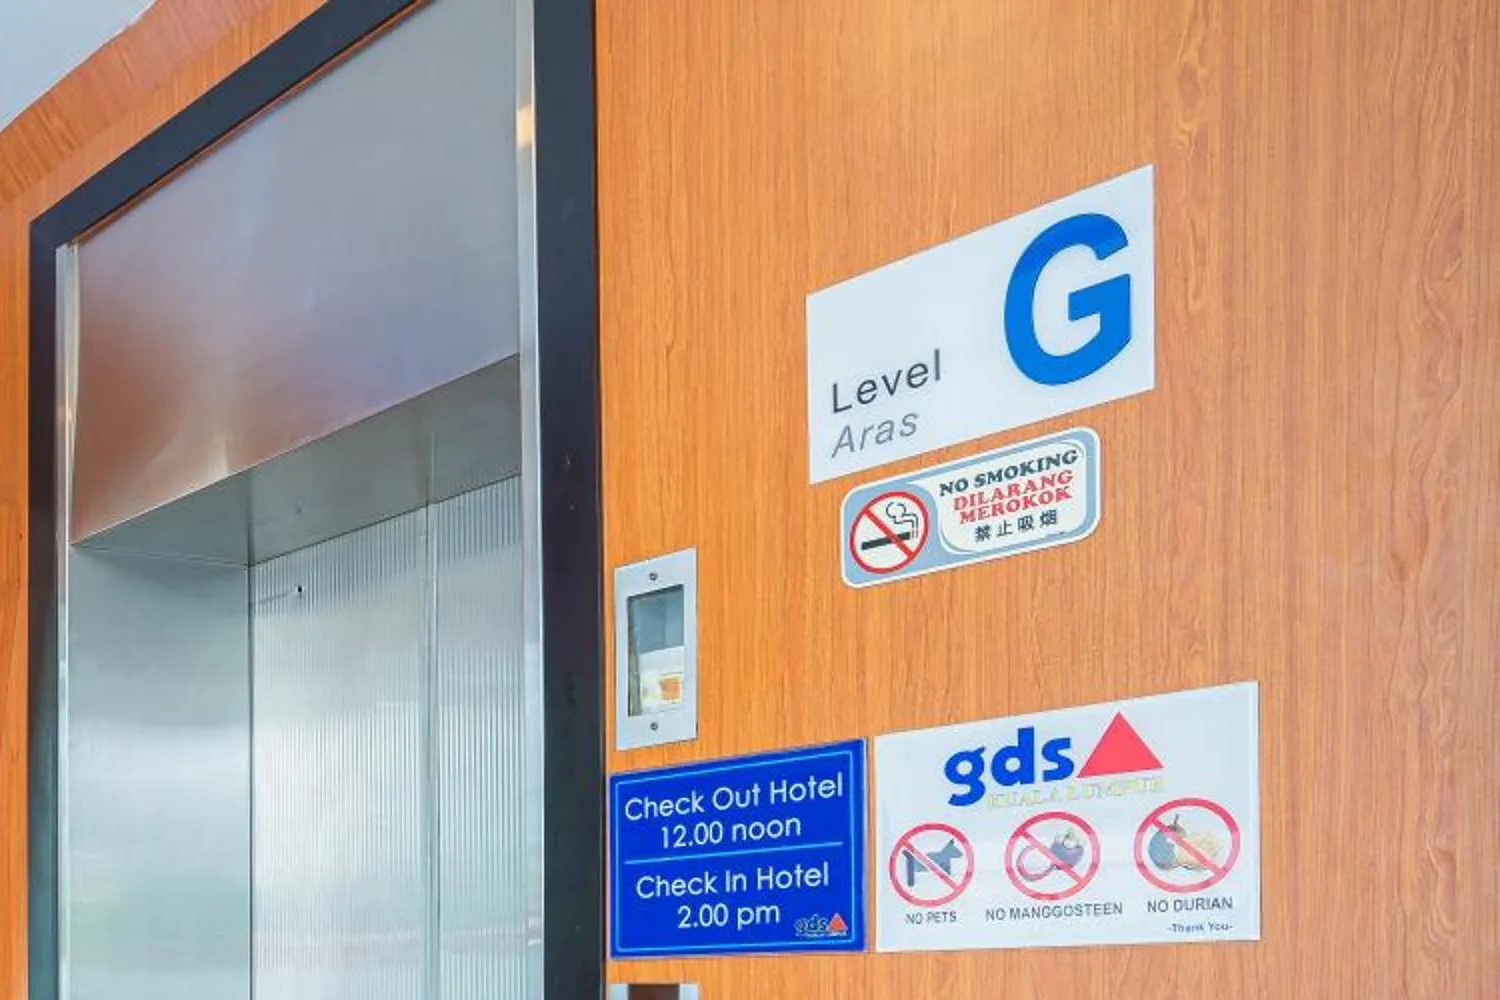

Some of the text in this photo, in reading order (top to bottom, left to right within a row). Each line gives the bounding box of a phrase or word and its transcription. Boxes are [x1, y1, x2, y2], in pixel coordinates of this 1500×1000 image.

[1004, 213, 1132, 385] G
[831, 348, 941, 413] Level
[831, 412, 918, 458] Aras
[939, 449, 1078, 497] NO SMOKING
[953, 469, 1074, 511] DILARANG
[959, 486, 1073, 525] MEROKOK
[975, 509, 1058, 543] 禁止吸烟
[944, 726, 1075, 807] gds
[624, 771, 843, 821] Check Out Hotel
[661, 816, 801, 849] 12.00 noon
[635, 860, 829, 900] Check In Hotel
[677, 903, 781, 931] 2.00 pm
[905, 910, 957, 925] NO PETS
[985, 902, 1123, 922] NO MANGGOSTEEN
[1147, 896, 1233, 914] NO DURIAN
